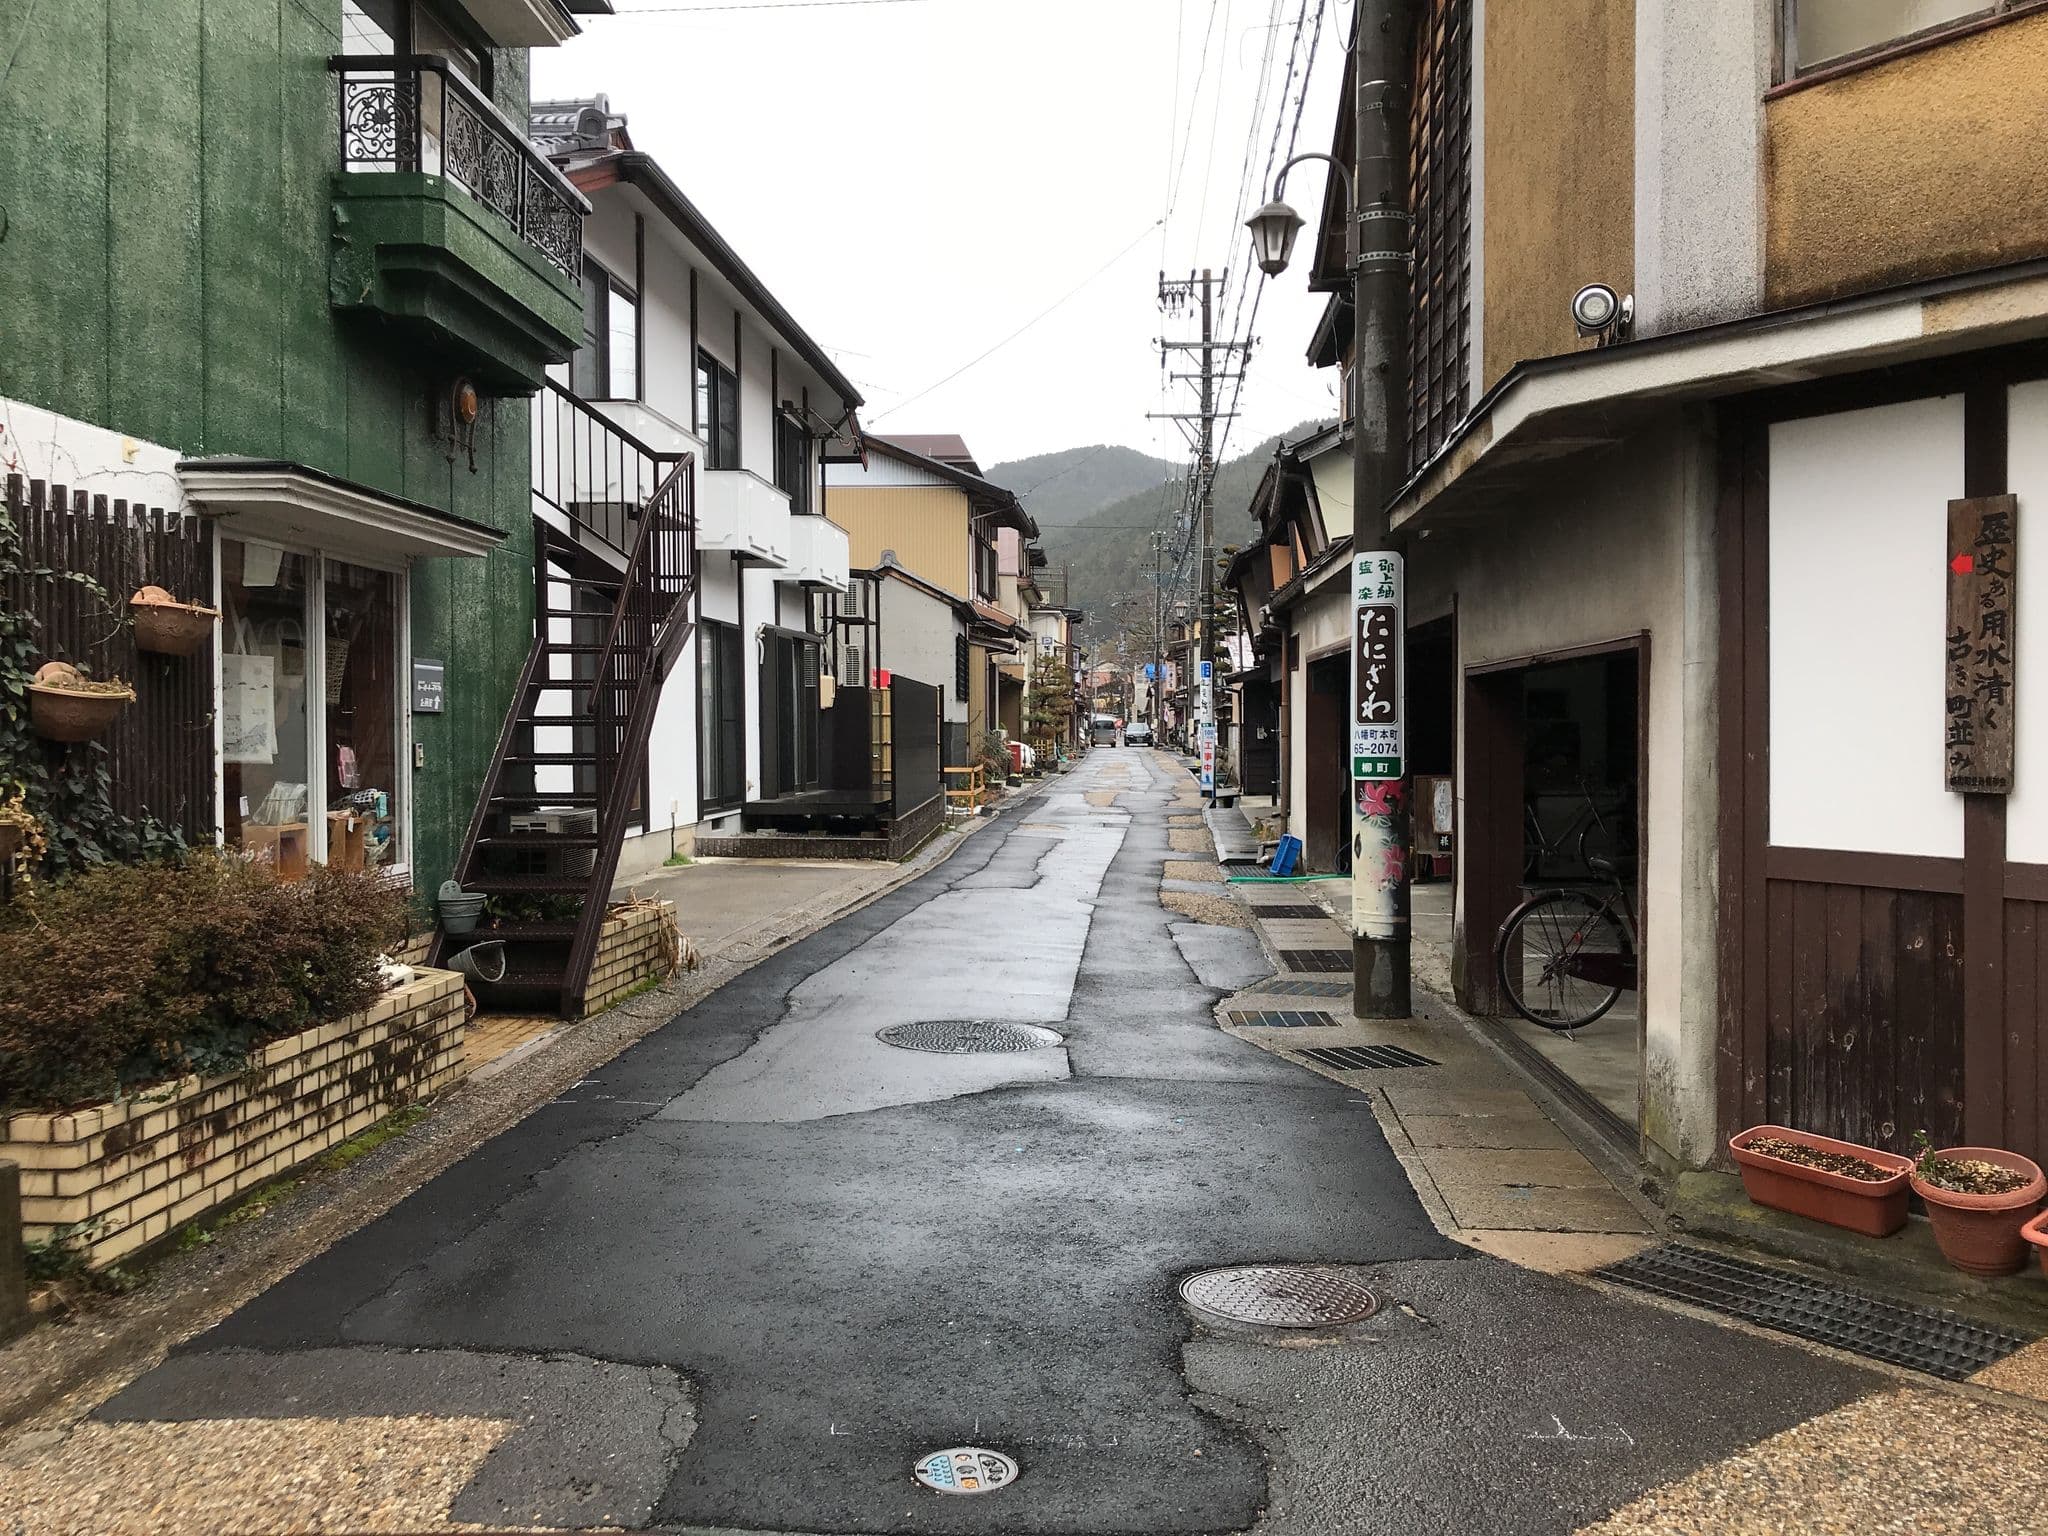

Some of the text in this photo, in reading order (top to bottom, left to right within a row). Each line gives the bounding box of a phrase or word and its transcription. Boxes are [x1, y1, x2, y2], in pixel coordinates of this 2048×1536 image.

[1358, 560, 1374, 600] 藍染
[1973, 511, 2013, 730] 歴史ある用水清く
[1360, 609, 1392, 721] たにざわ
[1946, 625, 1978, 771] 古き町並み
[1354, 728, 1398, 740] 八幡町本町
[1354, 742, 1398, 754] 65-2074
[1203, 741, 1213, 773] 工事中
